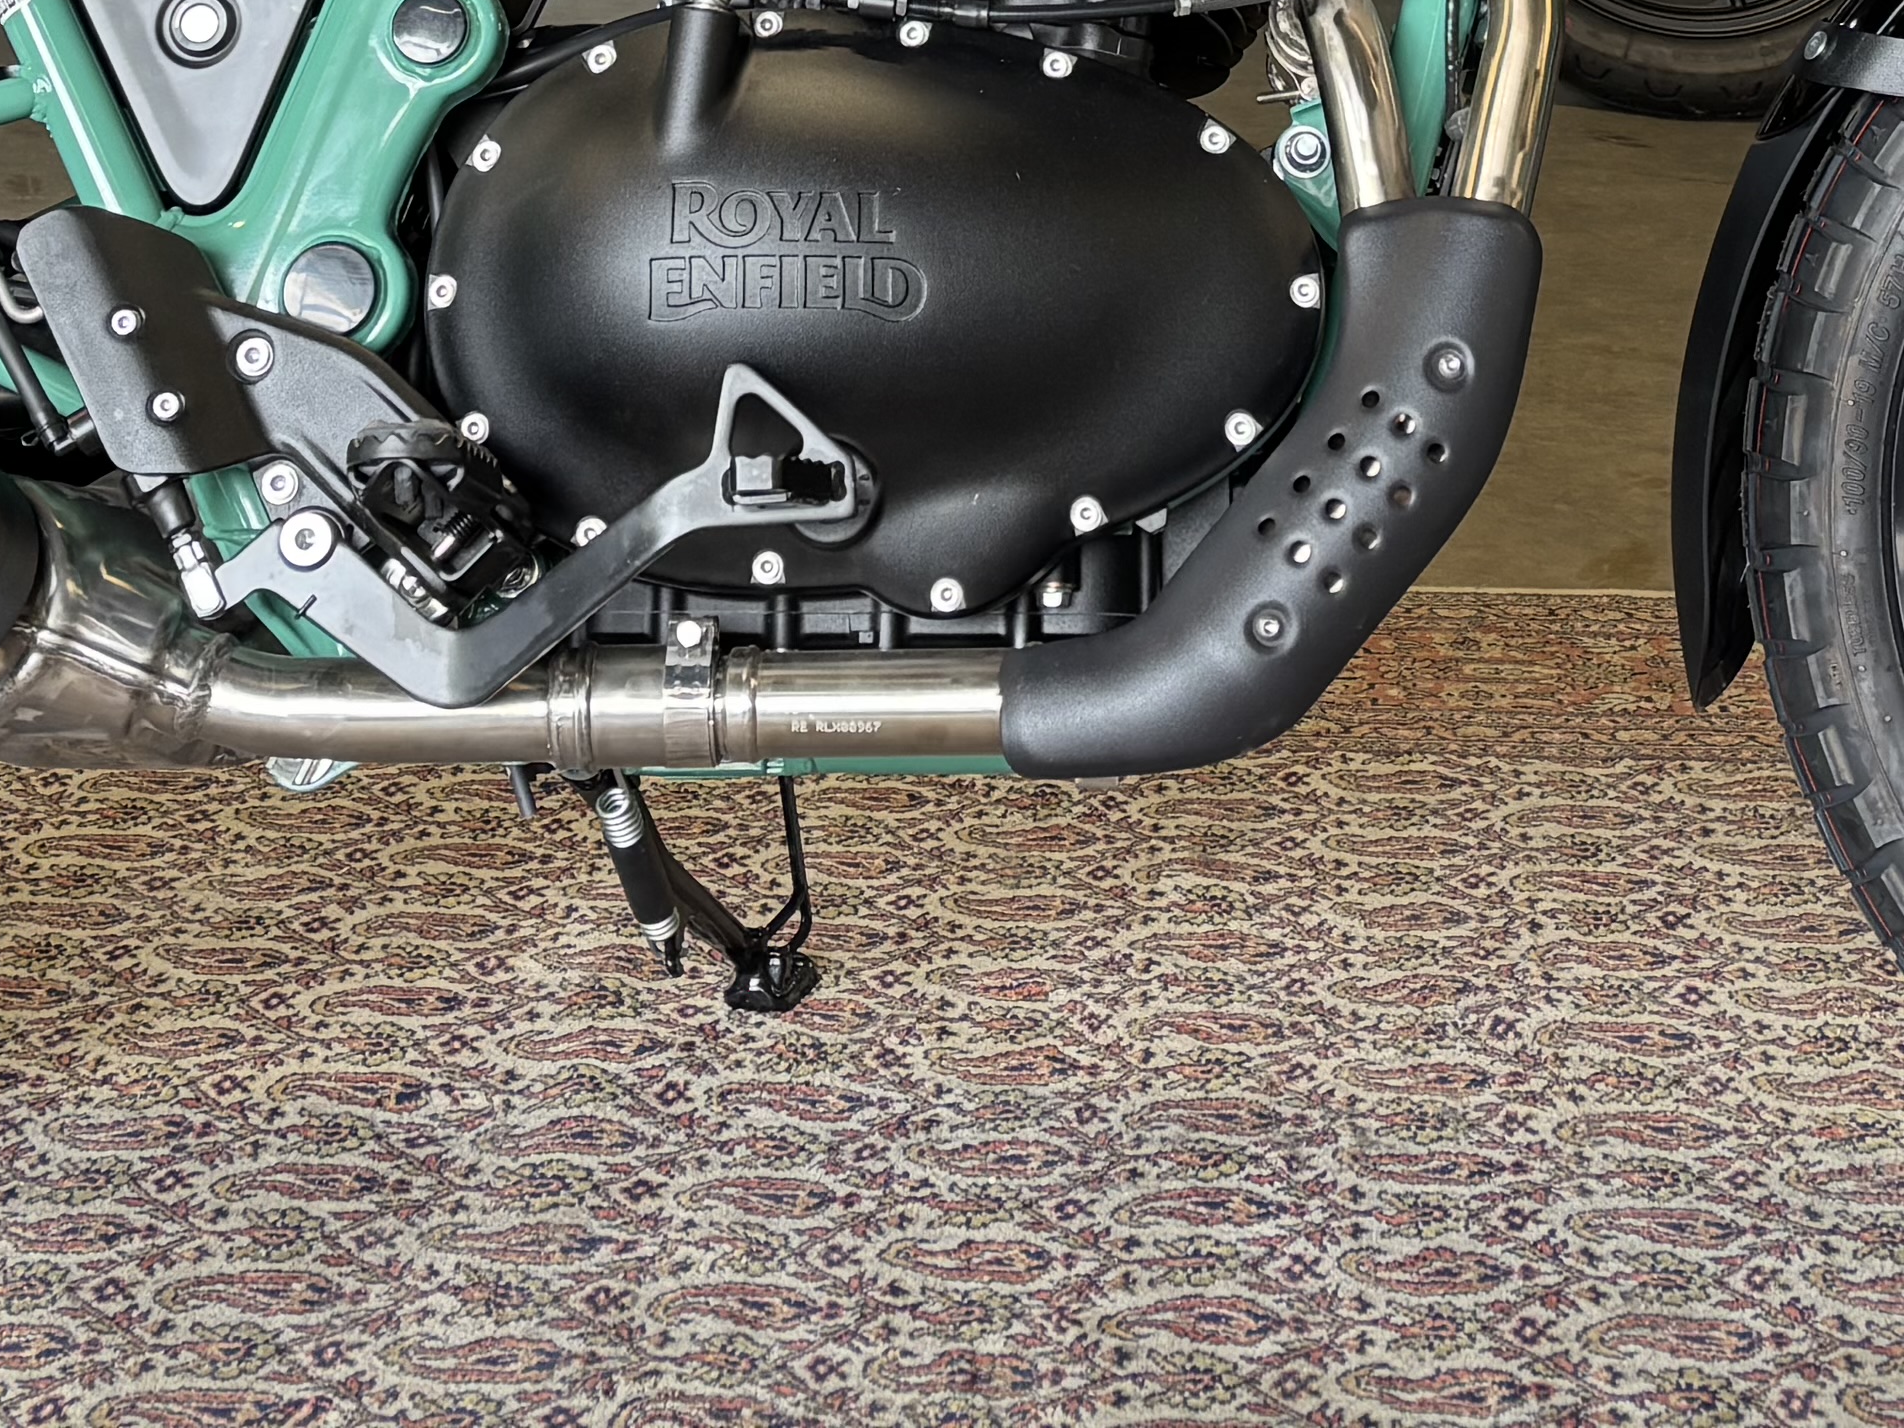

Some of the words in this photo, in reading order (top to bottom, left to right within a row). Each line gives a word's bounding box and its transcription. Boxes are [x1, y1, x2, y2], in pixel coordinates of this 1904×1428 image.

[670, 180, 896, 248] ROYAL
[649, 252, 928, 322] ENFIELD
[791, 719, 809, 733] RE
